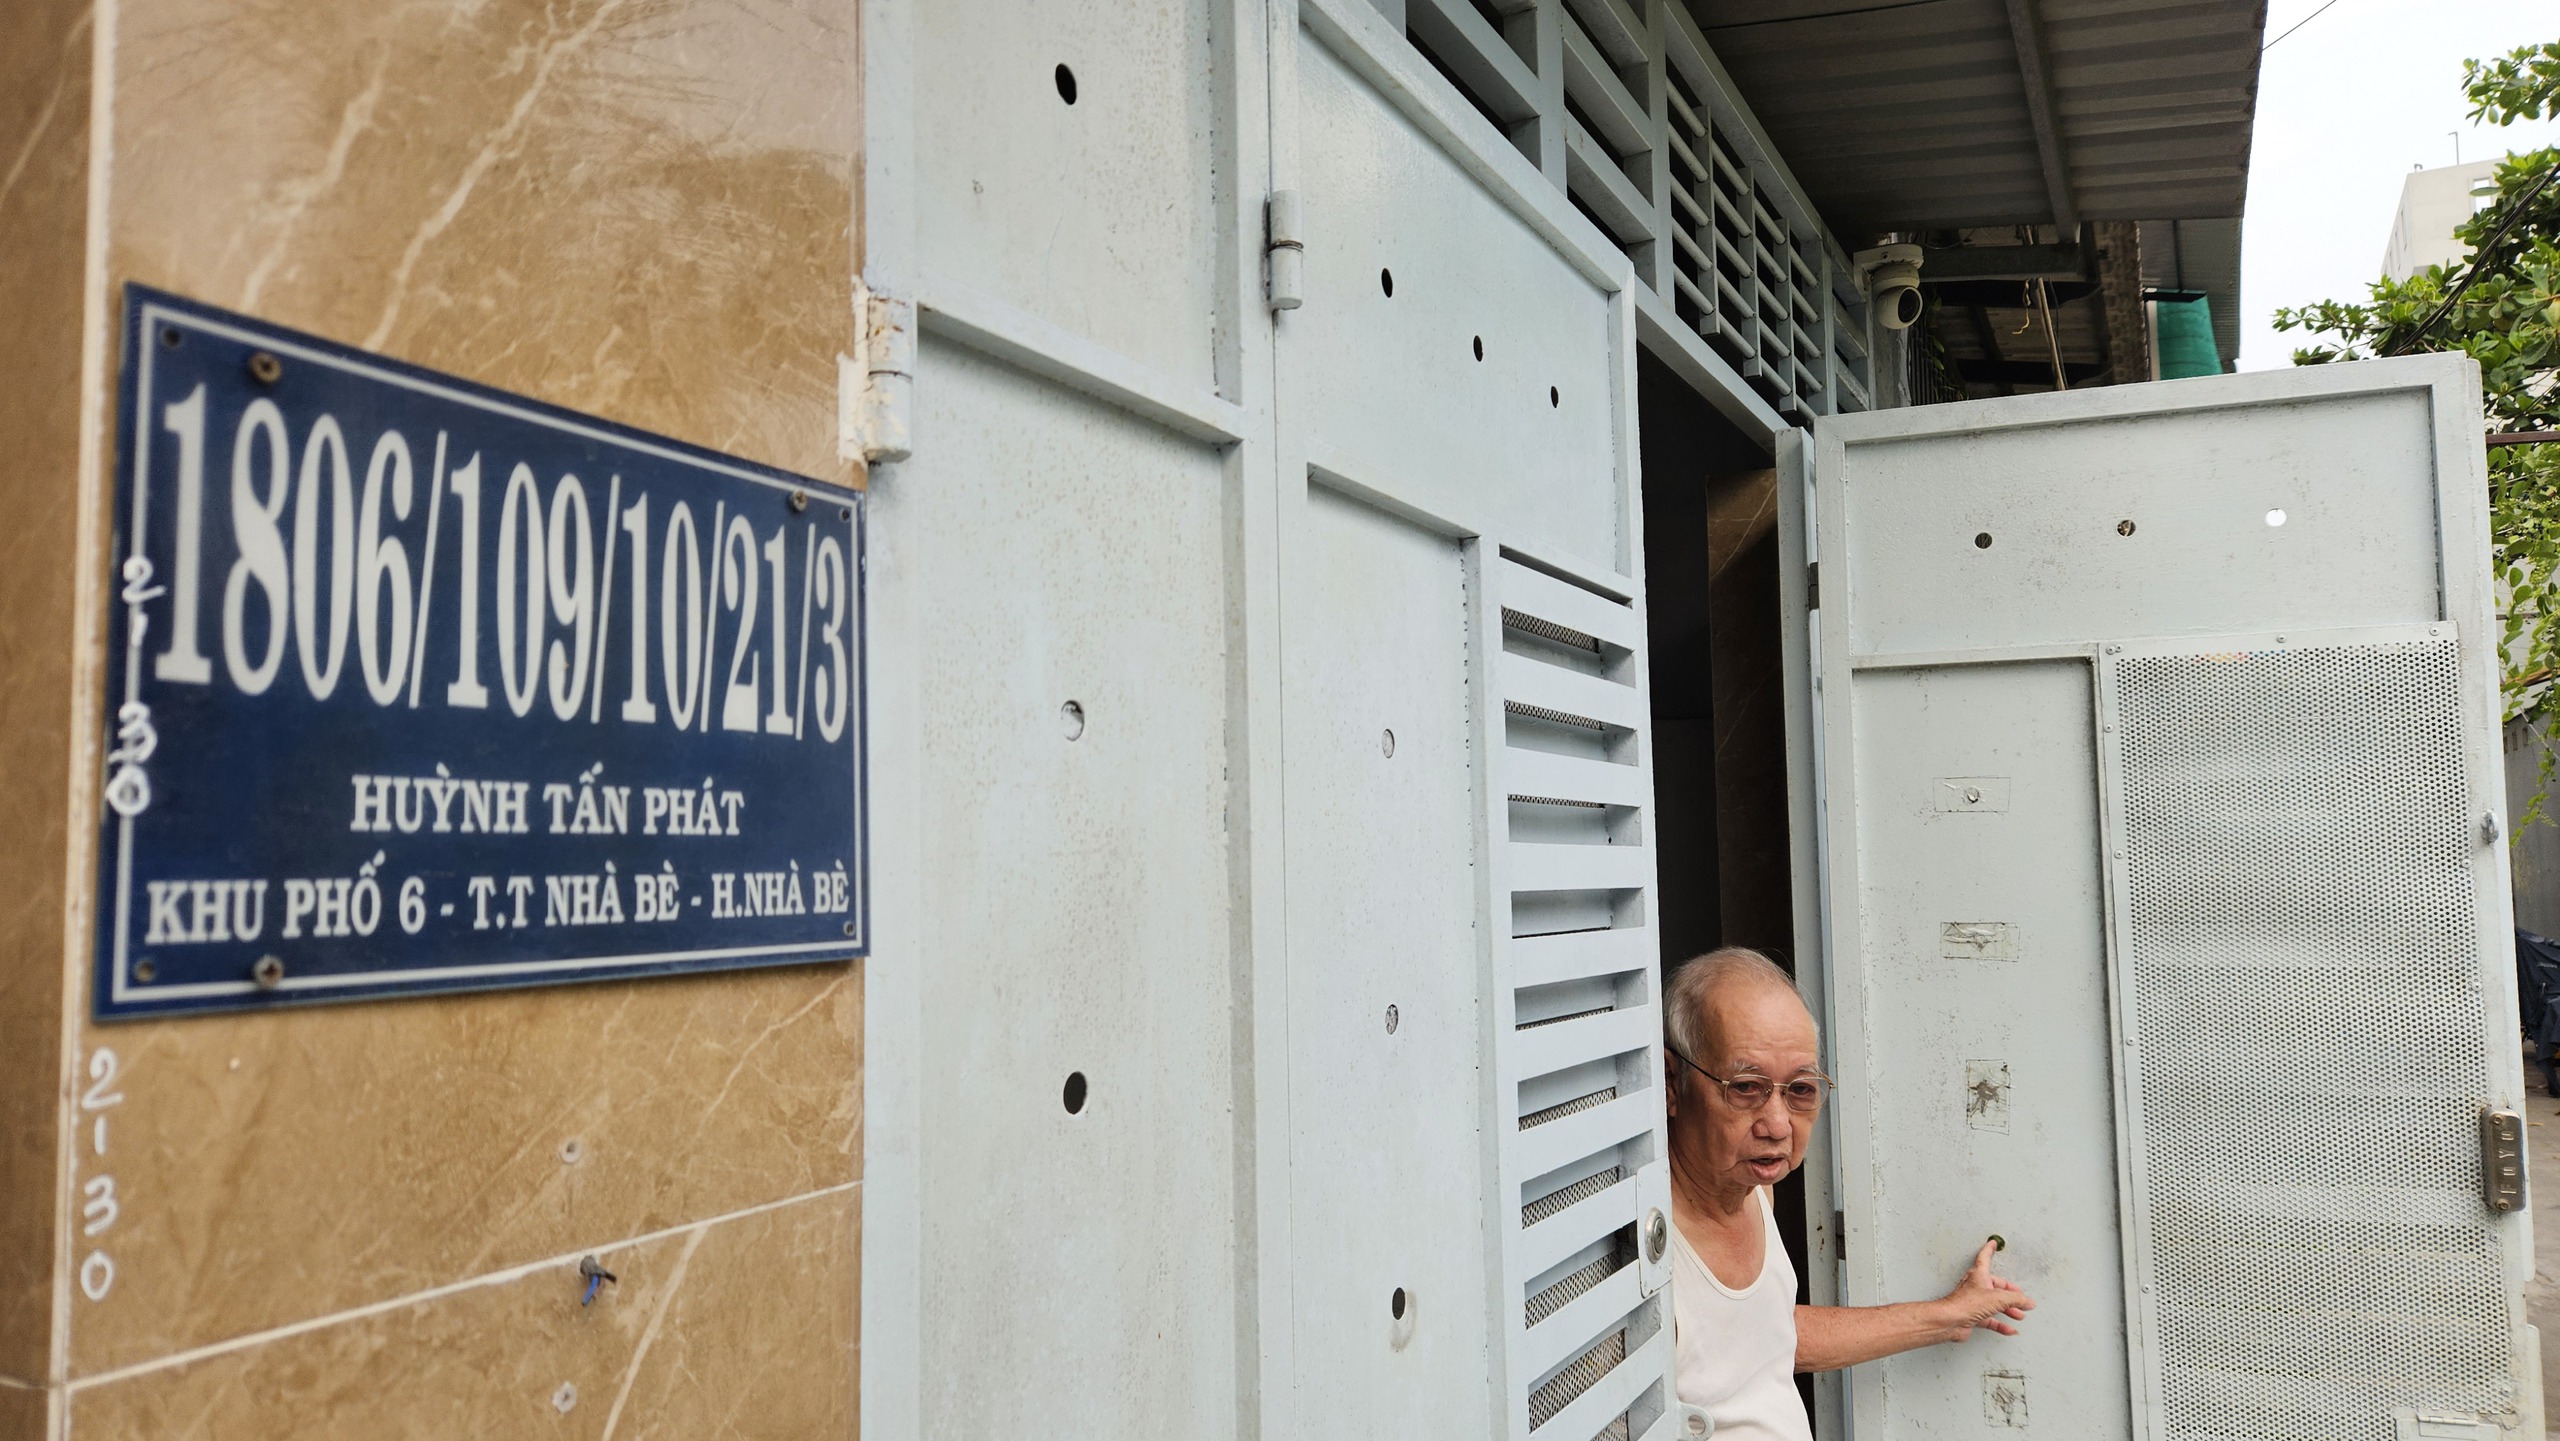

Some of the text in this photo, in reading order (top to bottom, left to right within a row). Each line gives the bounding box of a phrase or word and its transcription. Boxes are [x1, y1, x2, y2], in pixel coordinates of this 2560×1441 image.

[155, 382, 848, 743] 1806/109/10/21/3
[350, 761, 745, 836] HUỲNH TẤN PHÁT
[145, 848, 850, 945] KHU PHỐ 6 - T.T NHÀ BÈ - H.NHÀ BÈ
